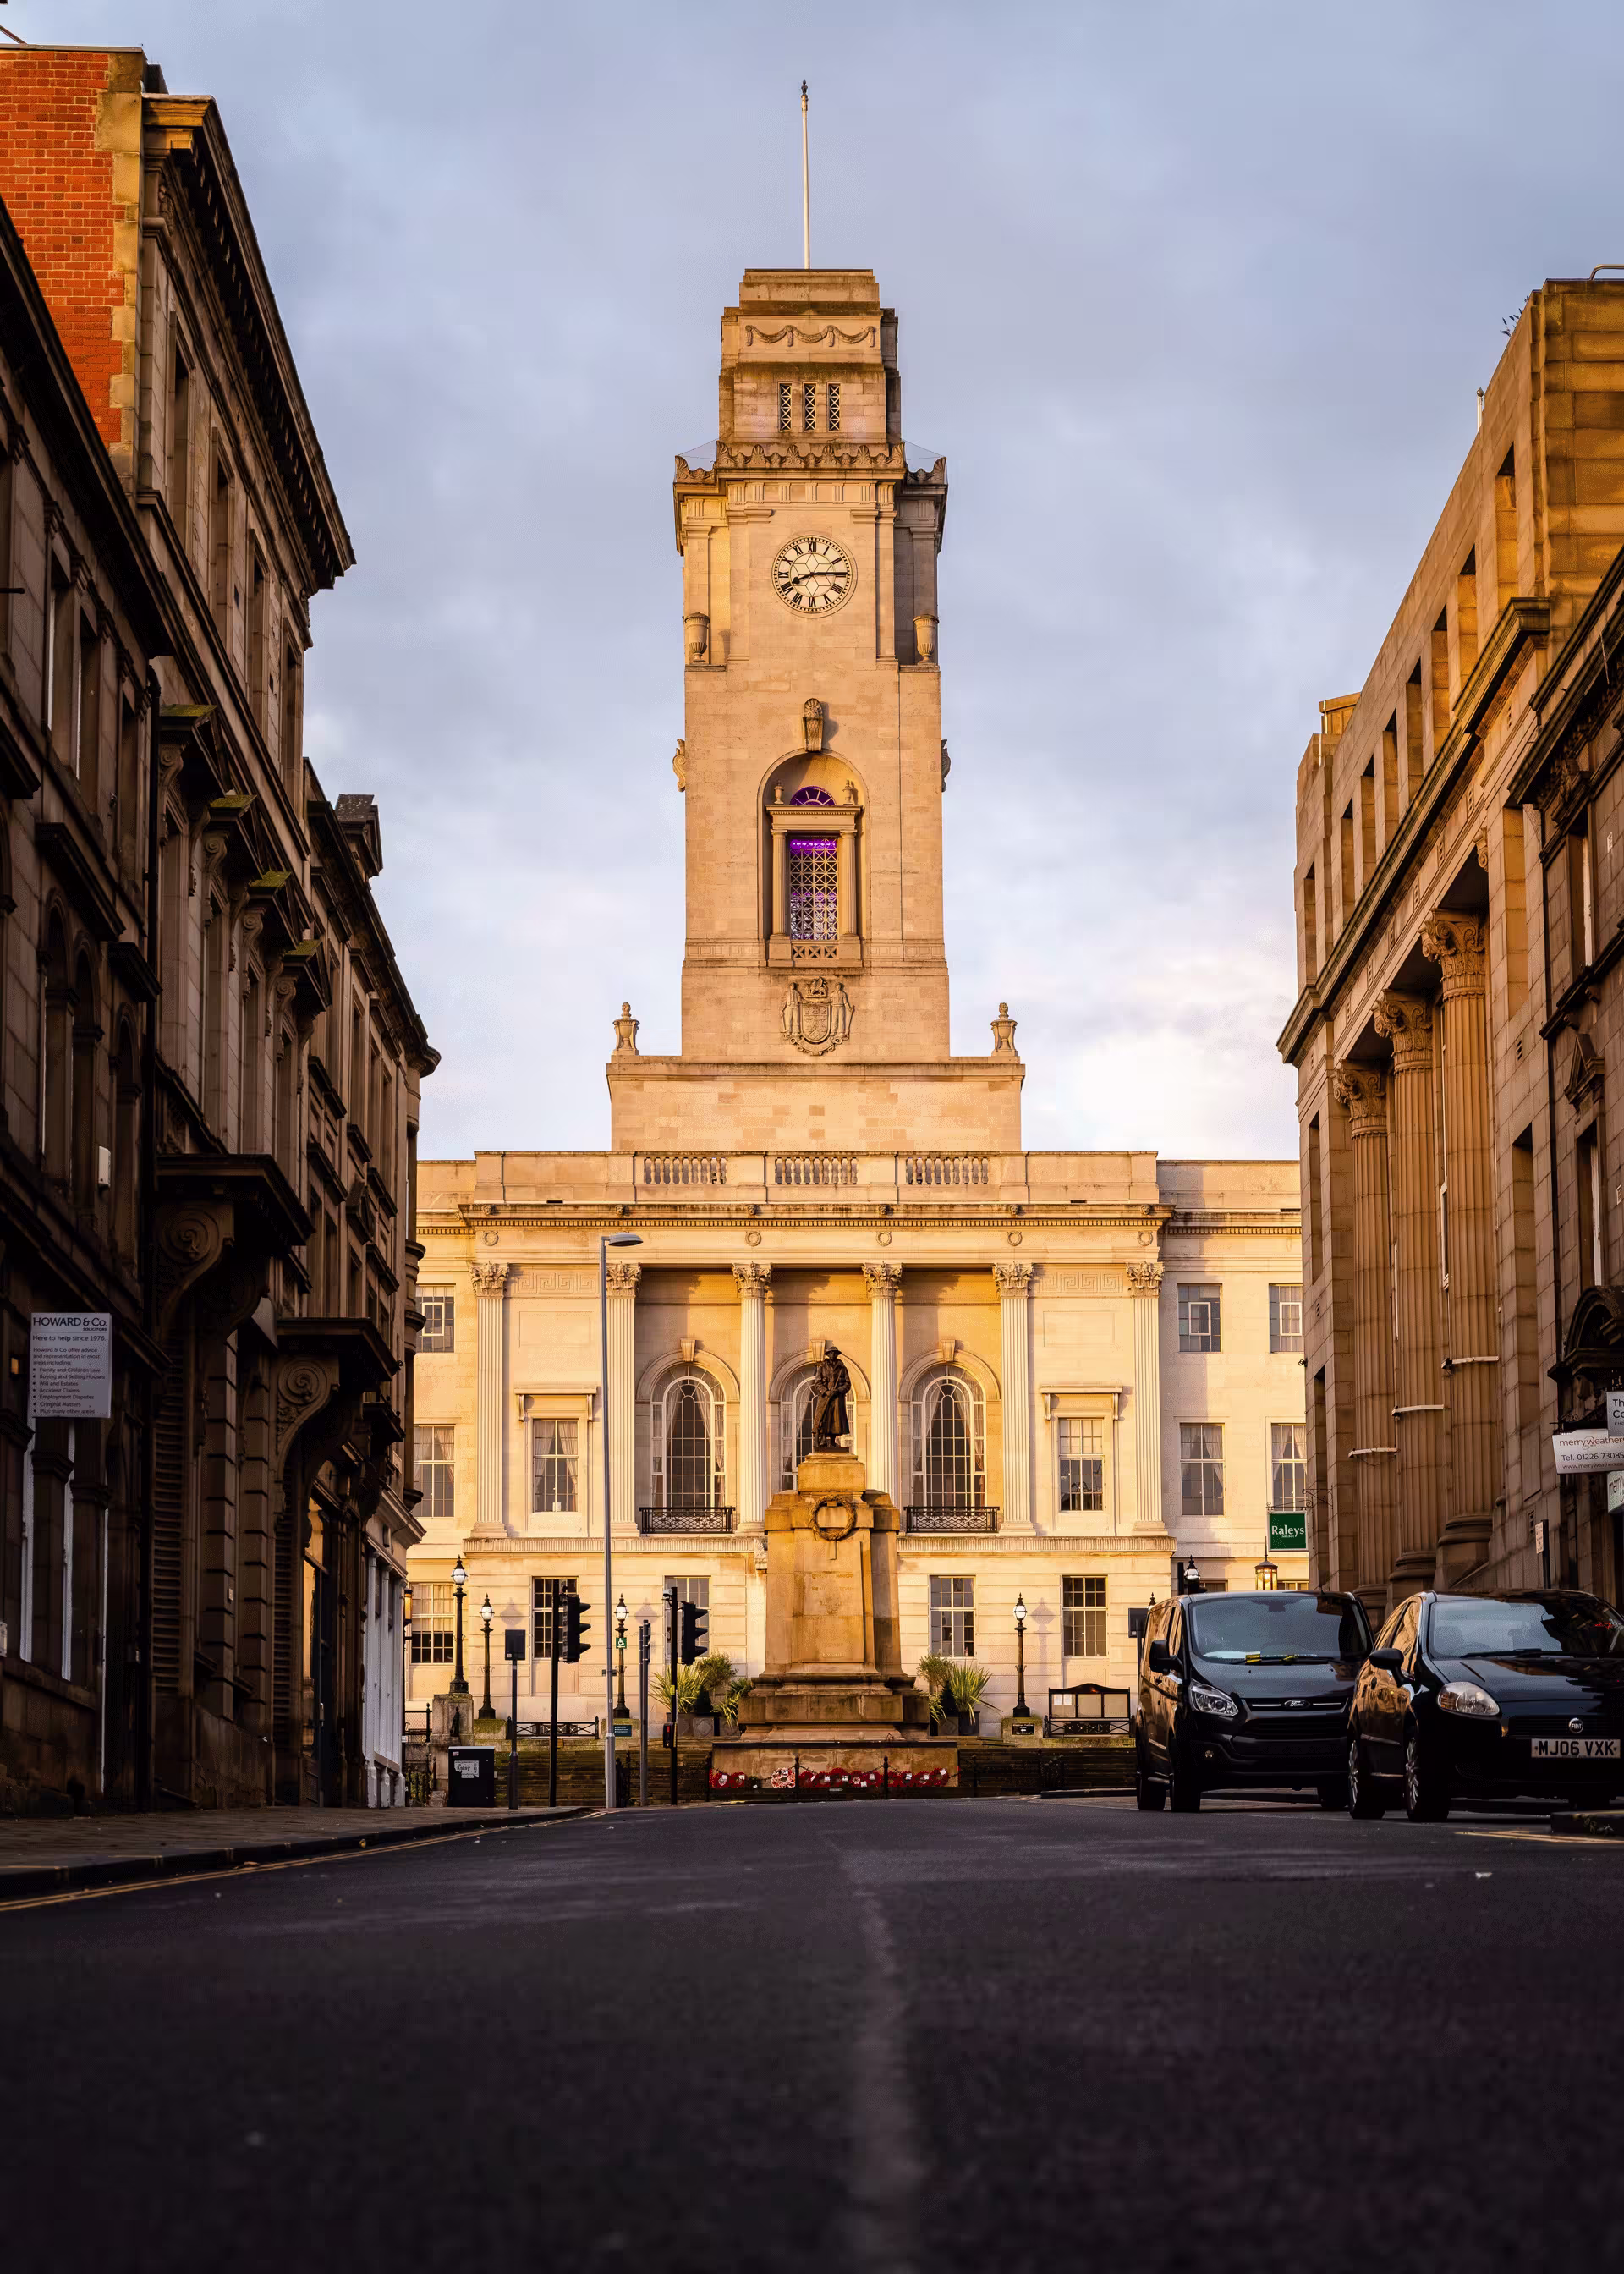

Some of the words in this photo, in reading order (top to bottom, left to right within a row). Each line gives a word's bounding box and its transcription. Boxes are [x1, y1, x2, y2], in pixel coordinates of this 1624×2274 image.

[33, 1317, 82, 1326] HOWARD
[83, 1317, 90, 1326] &
[91, 1317, 107, 1326] Co.
[1272, 1524, 1304, 1537] Raleys
[1539, 1740, 1580, 1755] MJ06
[1585, 1740, 1614, 1756] VXK
